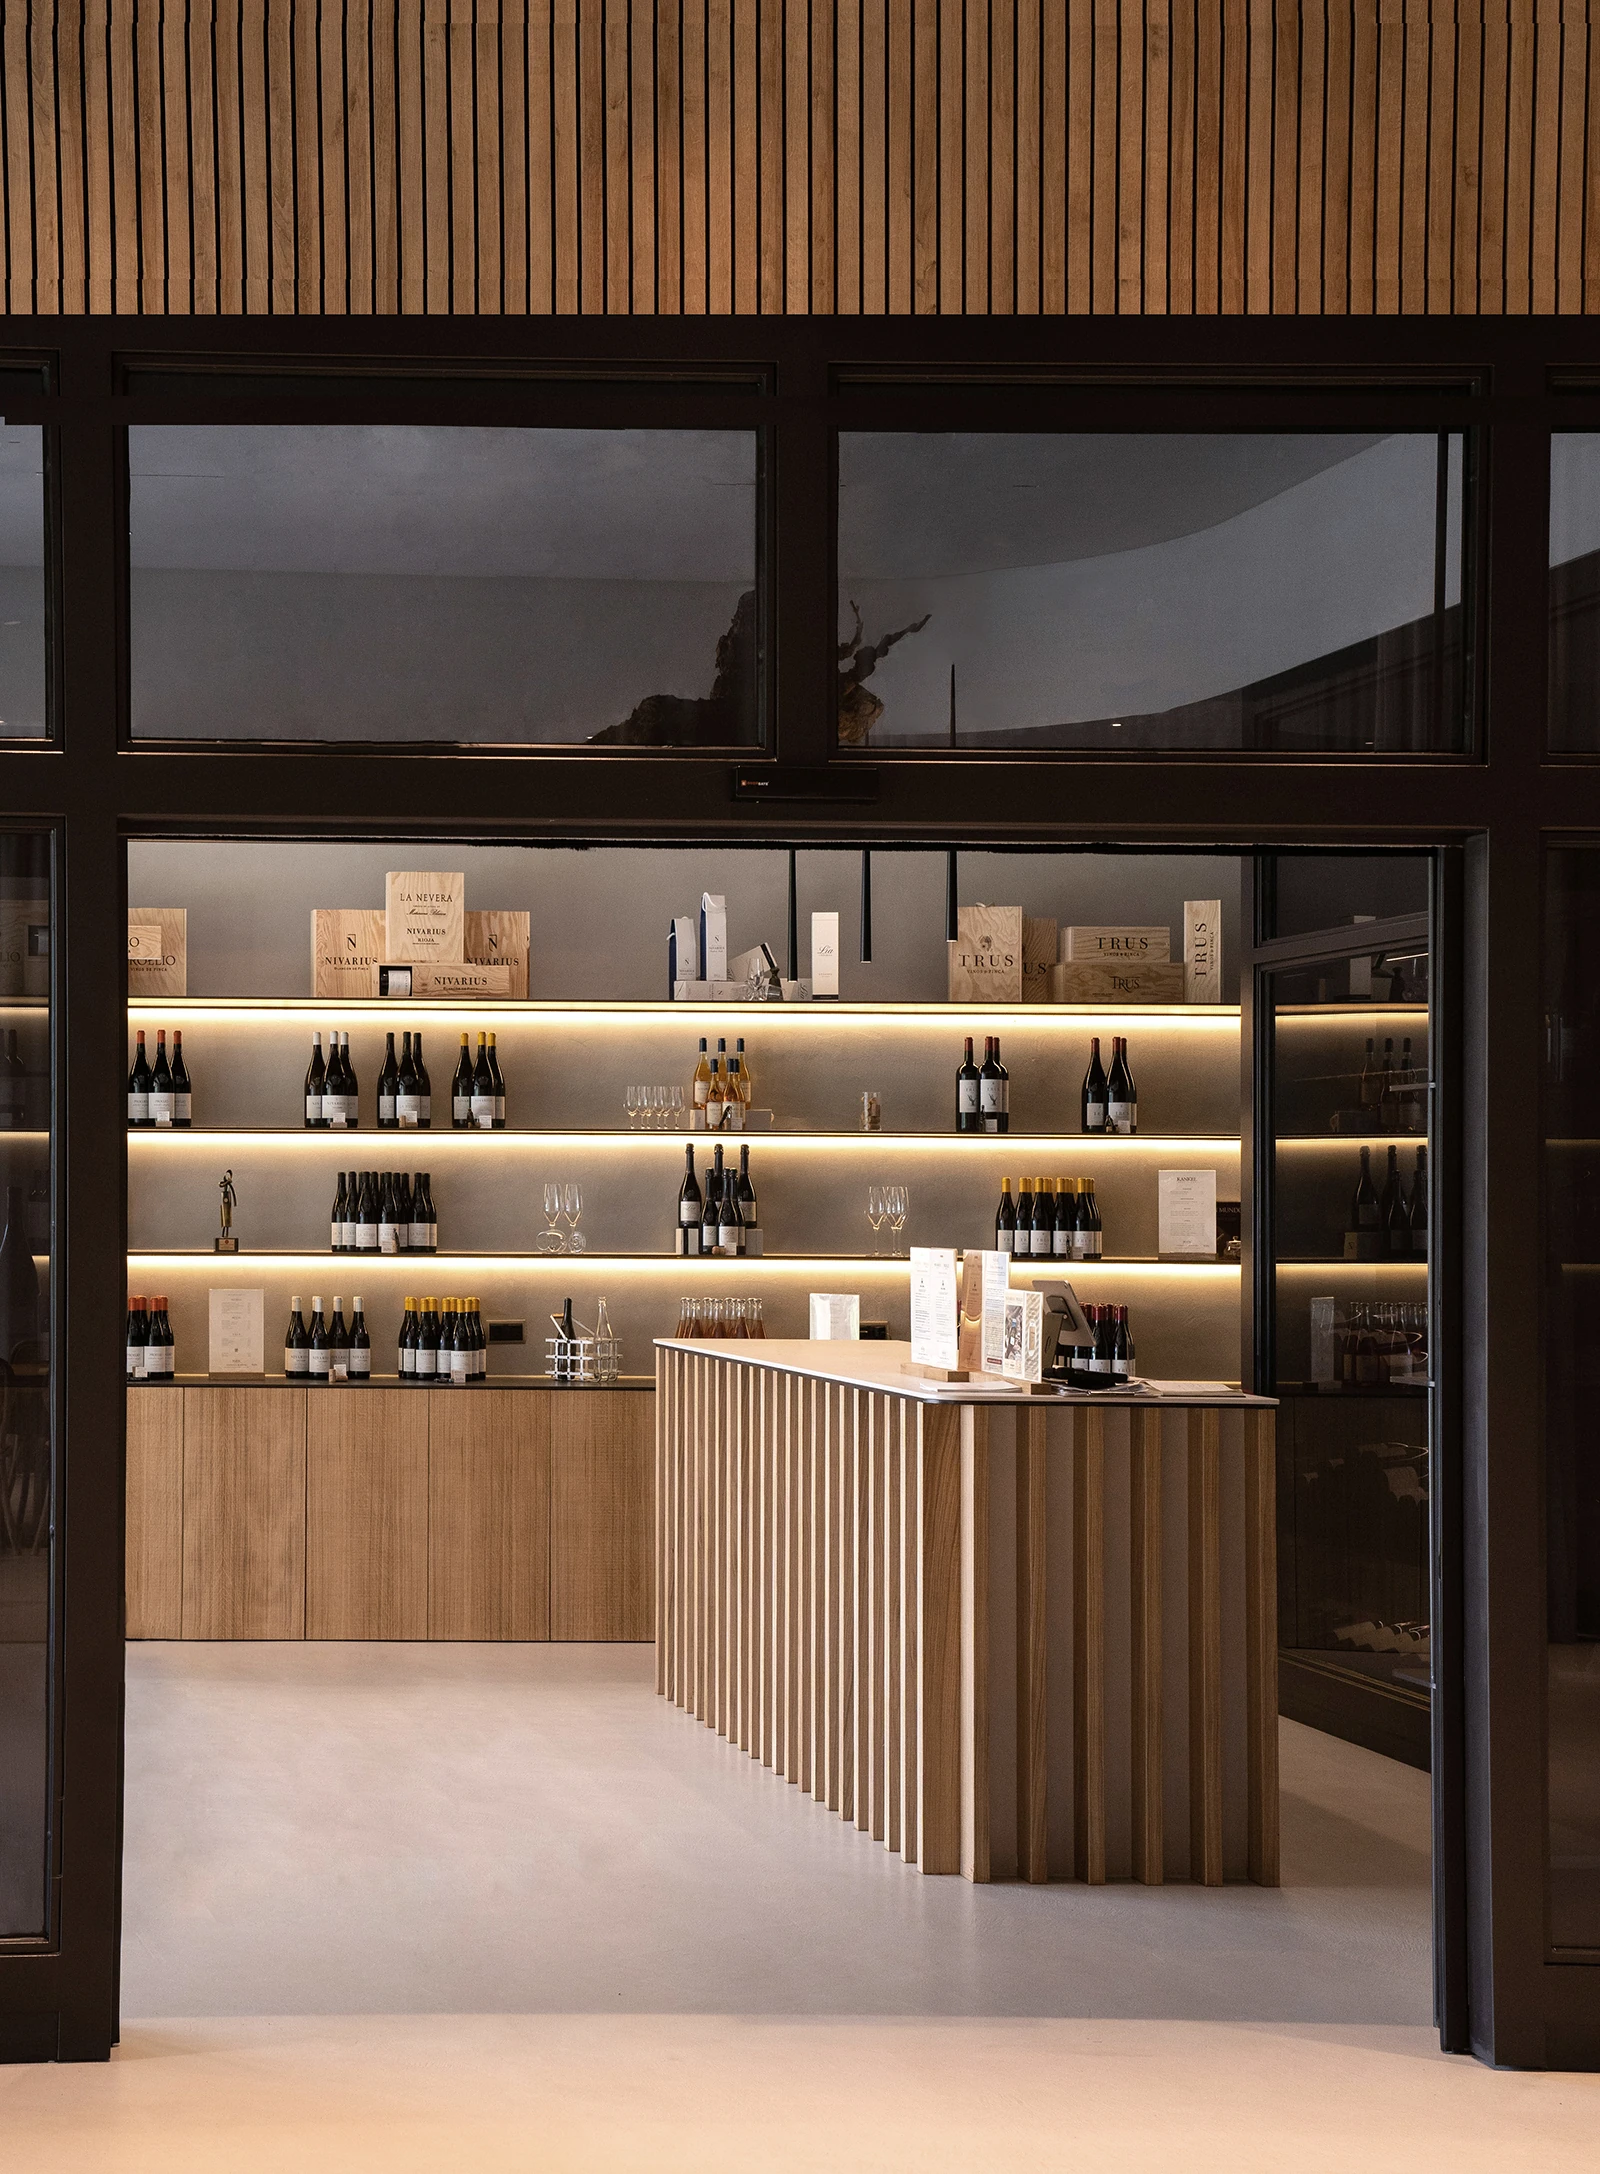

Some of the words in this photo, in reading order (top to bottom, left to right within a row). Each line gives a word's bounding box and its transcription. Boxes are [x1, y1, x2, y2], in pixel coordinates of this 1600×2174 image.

[400, 893, 413, 901] LA
[416, 893, 453, 902] NEVERA
[1096, 936, 1148, 950] TRUS
[1194, 923, 1207, 980] TRUS
[129, 955, 176, 966] ROELIO
[325, 956, 378, 965] NIVARIUS
[467, 957, 519, 966] NIVARIUS
[959, 954, 1014, 967] TRUS
[1023, 962, 1047, 975] US
[434, 976, 488, 986] NIVARIUS
